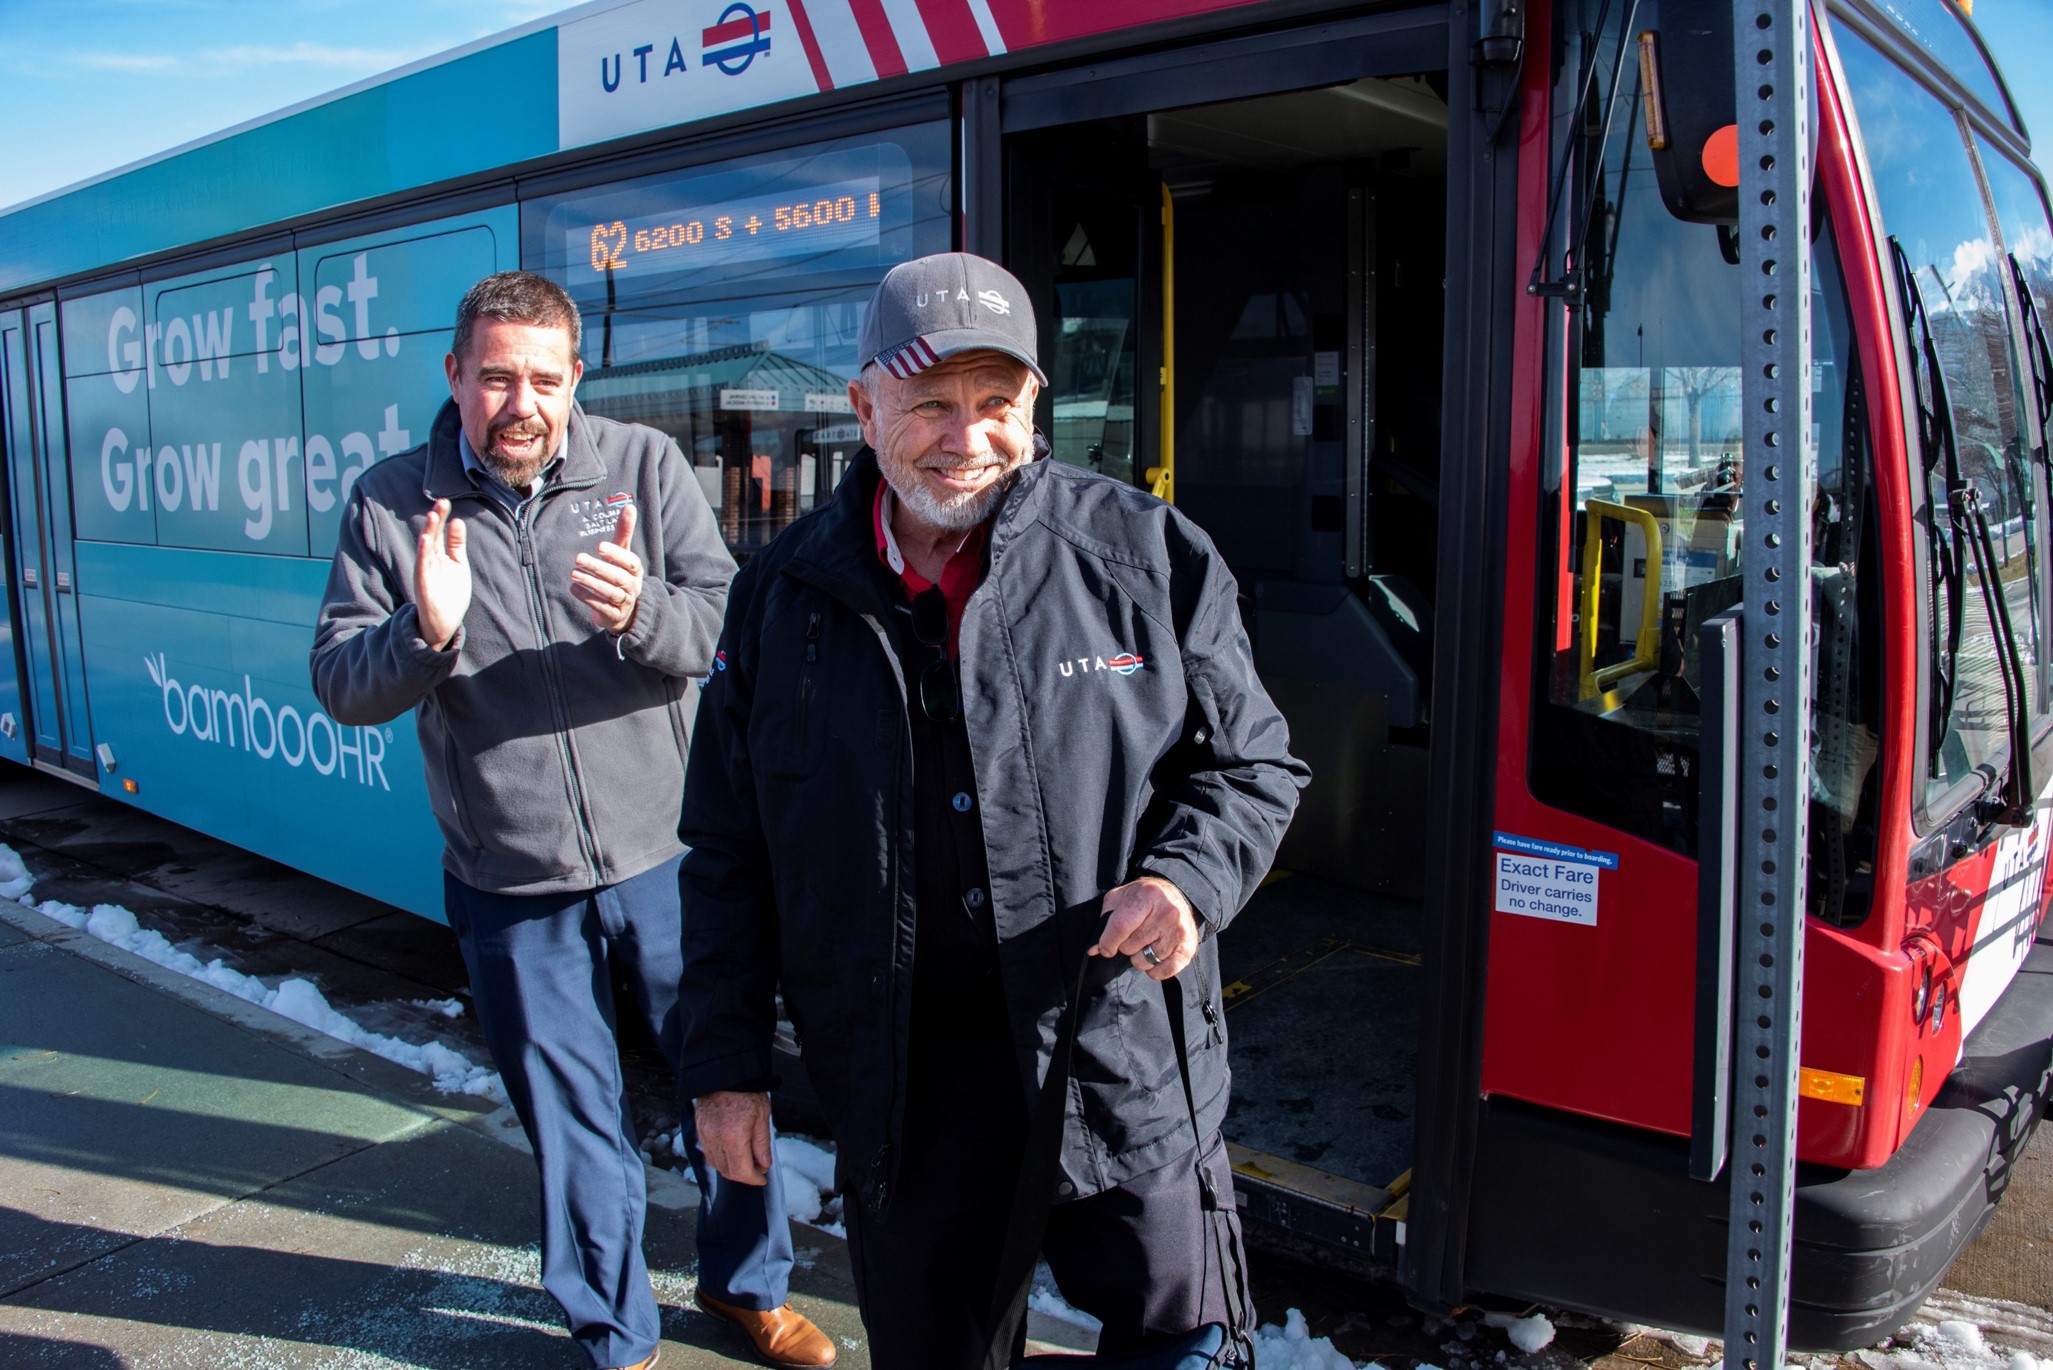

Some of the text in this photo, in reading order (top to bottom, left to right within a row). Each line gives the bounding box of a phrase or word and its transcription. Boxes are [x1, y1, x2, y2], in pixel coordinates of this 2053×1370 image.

[602, 36, 687, 93] UTA
[591, 221, 627, 272] 62
[634, 221, 703, 252] 6200
[715, 216, 732, 240] S
[775, 197, 855, 232] 5600
[916, 287, 970, 308] UTA
[108, 251, 400, 393] Grow fast.
[101, 427, 222, 512] Grow
[571, 499, 602, 514] UTA
[580, 524, 615, 537] BUSINESS
[1059, 656, 1107, 677] UTA
[158, 652, 391, 791] bambooHR
[1497, 836, 1613, 865] Please have fare ready prior to boarding.
[1501, 858, 1594, 884] Exact Fare
[1501, 879, 1592, 903] Driver carries
[1509, 897, 1583, 917] no change.
